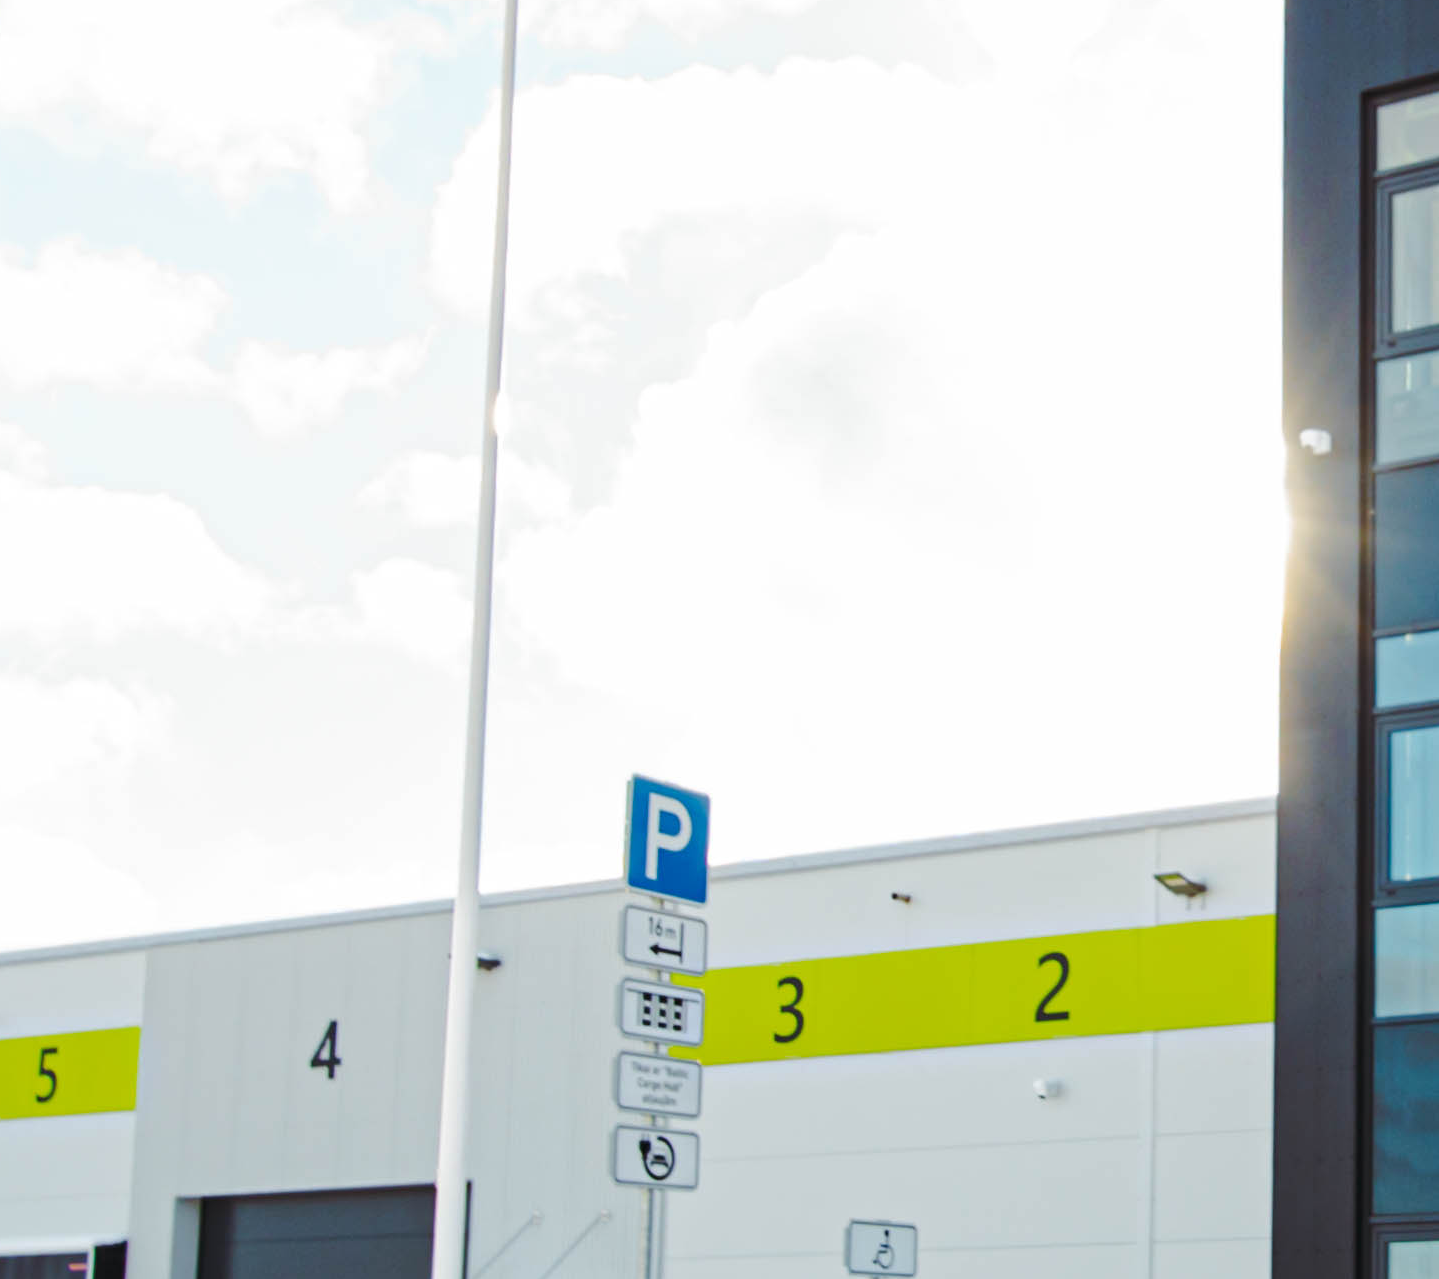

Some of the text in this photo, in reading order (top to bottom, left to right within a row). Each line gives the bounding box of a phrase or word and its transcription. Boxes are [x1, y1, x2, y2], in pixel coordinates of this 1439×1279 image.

[645, 792, 693, 881] P
[773, 976, 805, 1044] 3
[1034, 951, 1070, 1023] 2
[35, 1047, 59, 1103] 5
[310, 1020, 342, 1079] 4
